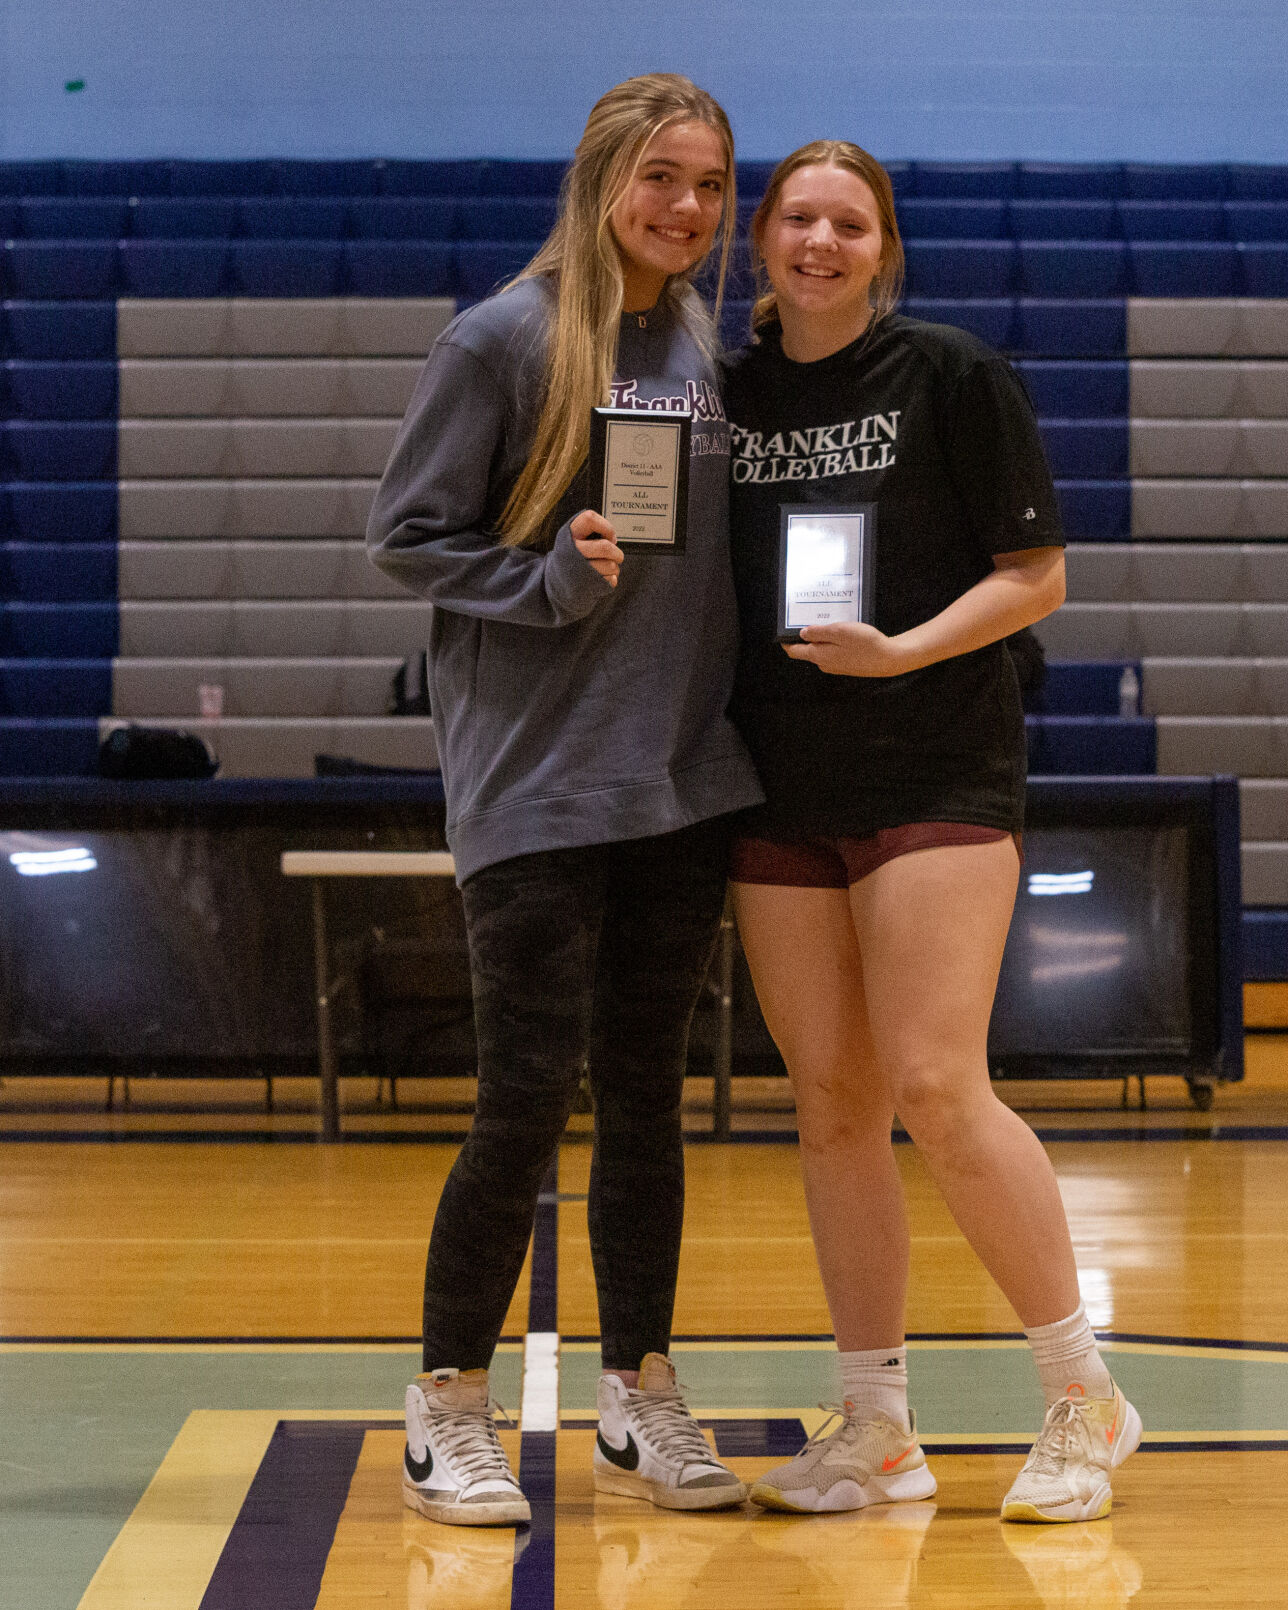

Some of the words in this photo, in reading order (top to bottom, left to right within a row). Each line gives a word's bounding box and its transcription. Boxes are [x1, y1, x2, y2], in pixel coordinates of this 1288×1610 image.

[733, 443, 896, 483] OLLEYBALL
[611, 501, 668, 510] TOURNAMENT
[796, 590, 854, 598] TOURNAMENT
